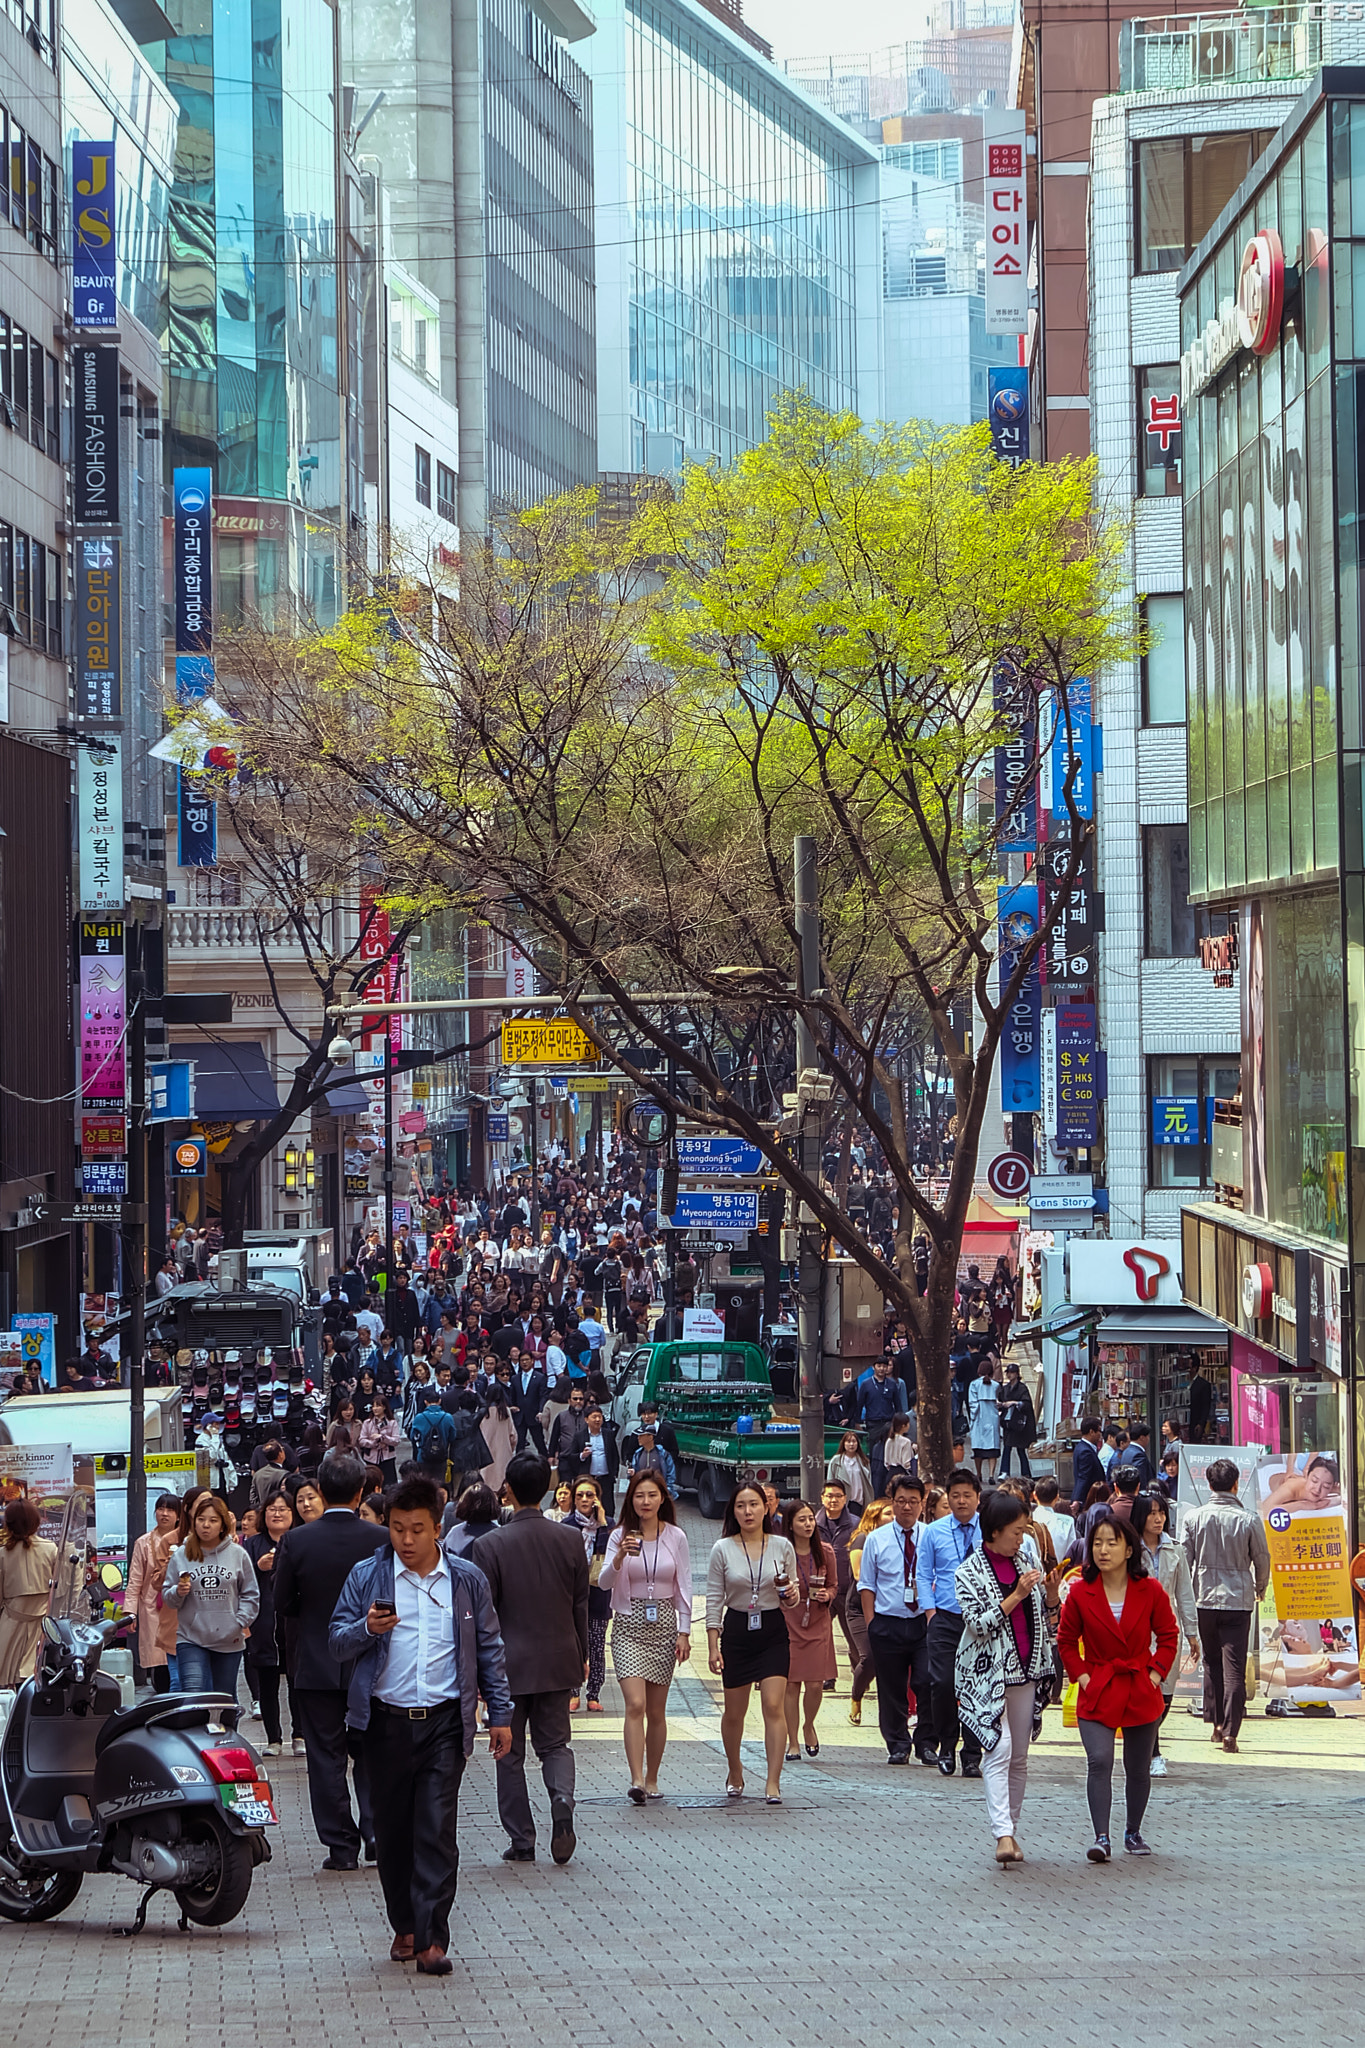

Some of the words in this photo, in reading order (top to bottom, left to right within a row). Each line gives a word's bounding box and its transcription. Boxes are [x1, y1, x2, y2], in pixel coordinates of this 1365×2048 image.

[992, 190, 1022, 276] 다이소
[74, 276, 115, 288] BEAUTY
[87, 298, 105, 313] 6F
[84, 352, 97, 411] SAMSUNG
[85, 415, 106, 503] FASHION
[183, 517, 203, 633] 우리종합금융
[87, 570, 112, 670] 단아의원
[87, 681, 98, 715] 피부과
[101, 681, 112, 715] 성형외과
[92, 771, 110, 822] 정성본
[87, 825, 116, 835] 샤브
[92, 838, 110, 888] 칼국수
[97, 891, 108, 899] B1
[83, 900, 120, 909] 773-1028
[1070, 889, 1087, 925] 카페
[84, 924, 122, 937] Nail
[95, 938, 110, 953] 퀸
[1073, 959, 1087, 970] 3F
[1058, 1020, 1093, 1029] Exchange
[1060, 1051, 1072, 1067] $
[1077, 1053, 1090, 1067] ¥
[1060, 1071, 1072, 1085] 元
[1074, 1073, 1093, 1083] HK$
[1061, 1088, 1072, 1101] €
[1075, 1089, 1093, 1100] SGD
[1164, 1107, 1189, 1133] 元
[84, 1128, 124, 1143] 상품권
[724, 1154, 743, 1164] 9-gil
[83, 1165, 125, 1179] 명문부동산
[73, 1204, 122, 1213] 솔라리아호텔
[712, 1195, 755, 1208] 명동10길
[1034, 1198, 1059, 1207] Lens
[1062, 1198, 1089, 1207] Story
[682, 1208, 732, 1217] Myeongdong
[733, 1208, 755, 1217] 10-gil
[6, 1453, 24, 1462] cafe
[25, 1452, 55, 1461] kinnor
[1270, 1512, 1289, 1528] 6F
[1292, 1542, 1342, 1560] 李惠卿
[190, 1565, 233, 1581] DICKIES
[204, 1577, 217, 1588] 22
[103, 1789, 179, 1816] Super
